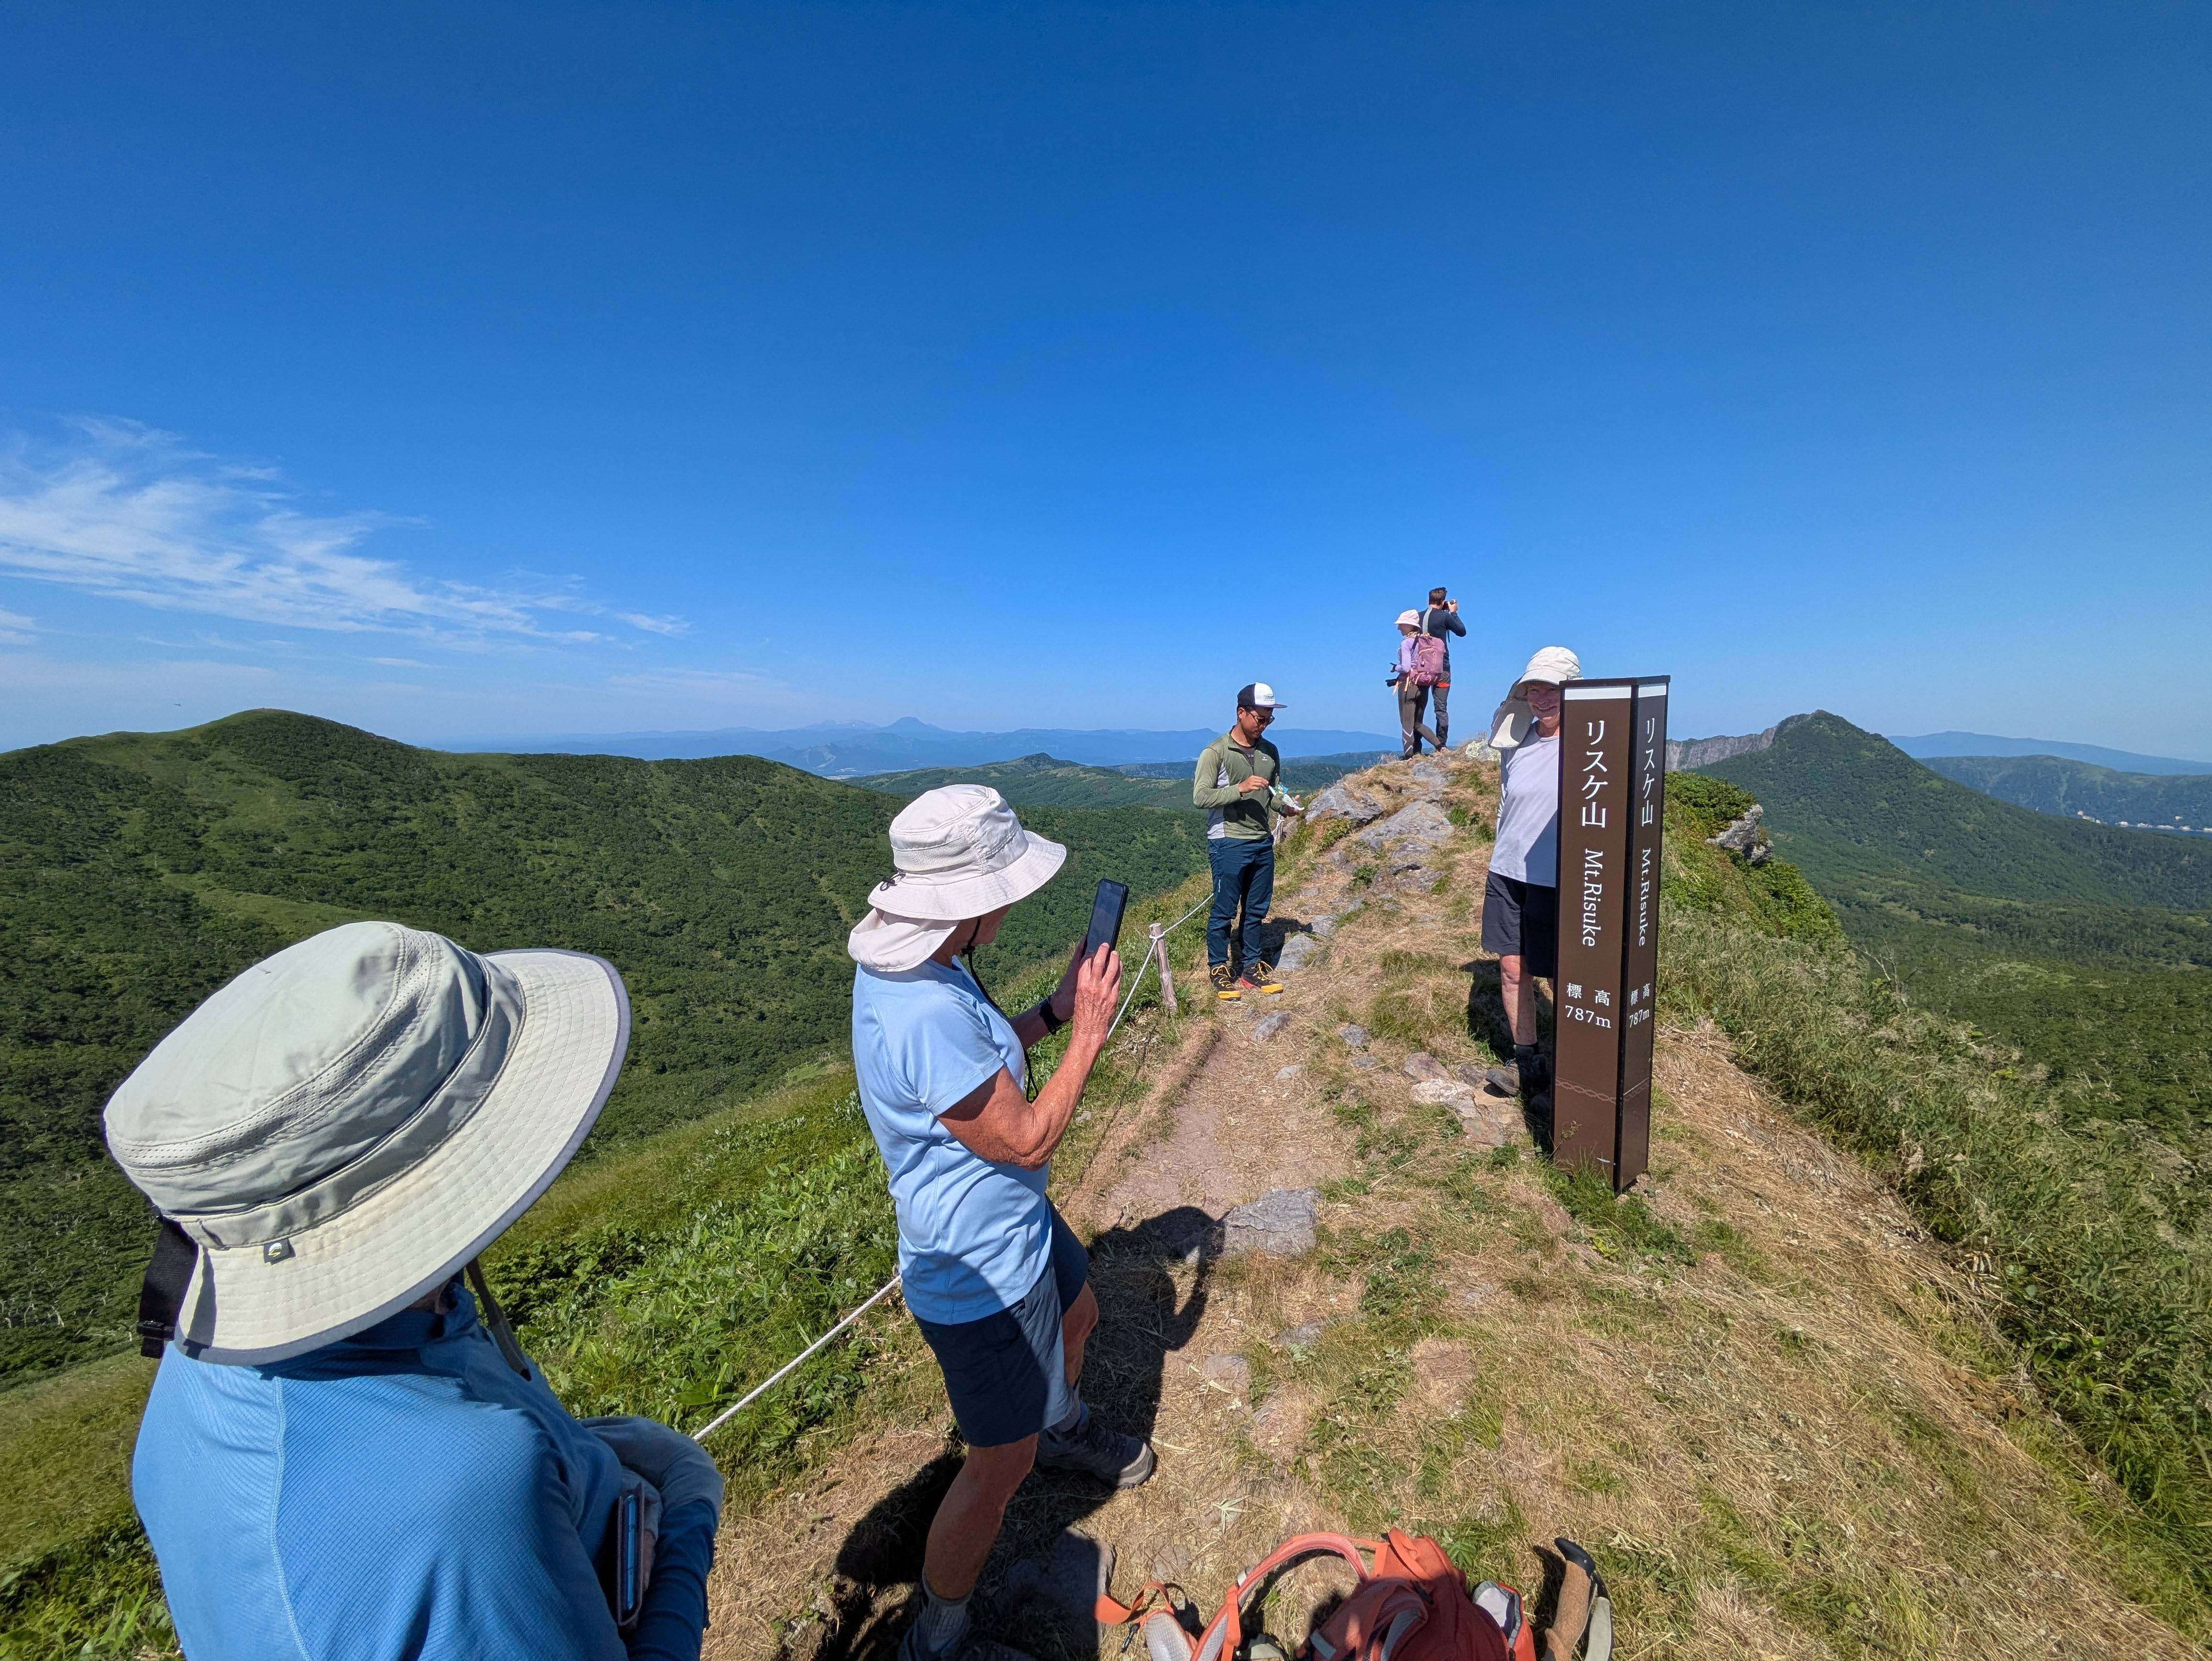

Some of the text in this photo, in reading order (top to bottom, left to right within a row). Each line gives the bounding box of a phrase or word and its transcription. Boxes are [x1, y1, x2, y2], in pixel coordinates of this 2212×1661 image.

[1582, 720, 1608, 828] リスケ山
[1641, 718, 1655, 827] リスケ山
[1565, 1005, 1612, 1029] 787m
[1629, 1009, 1650, 1028] 787m
